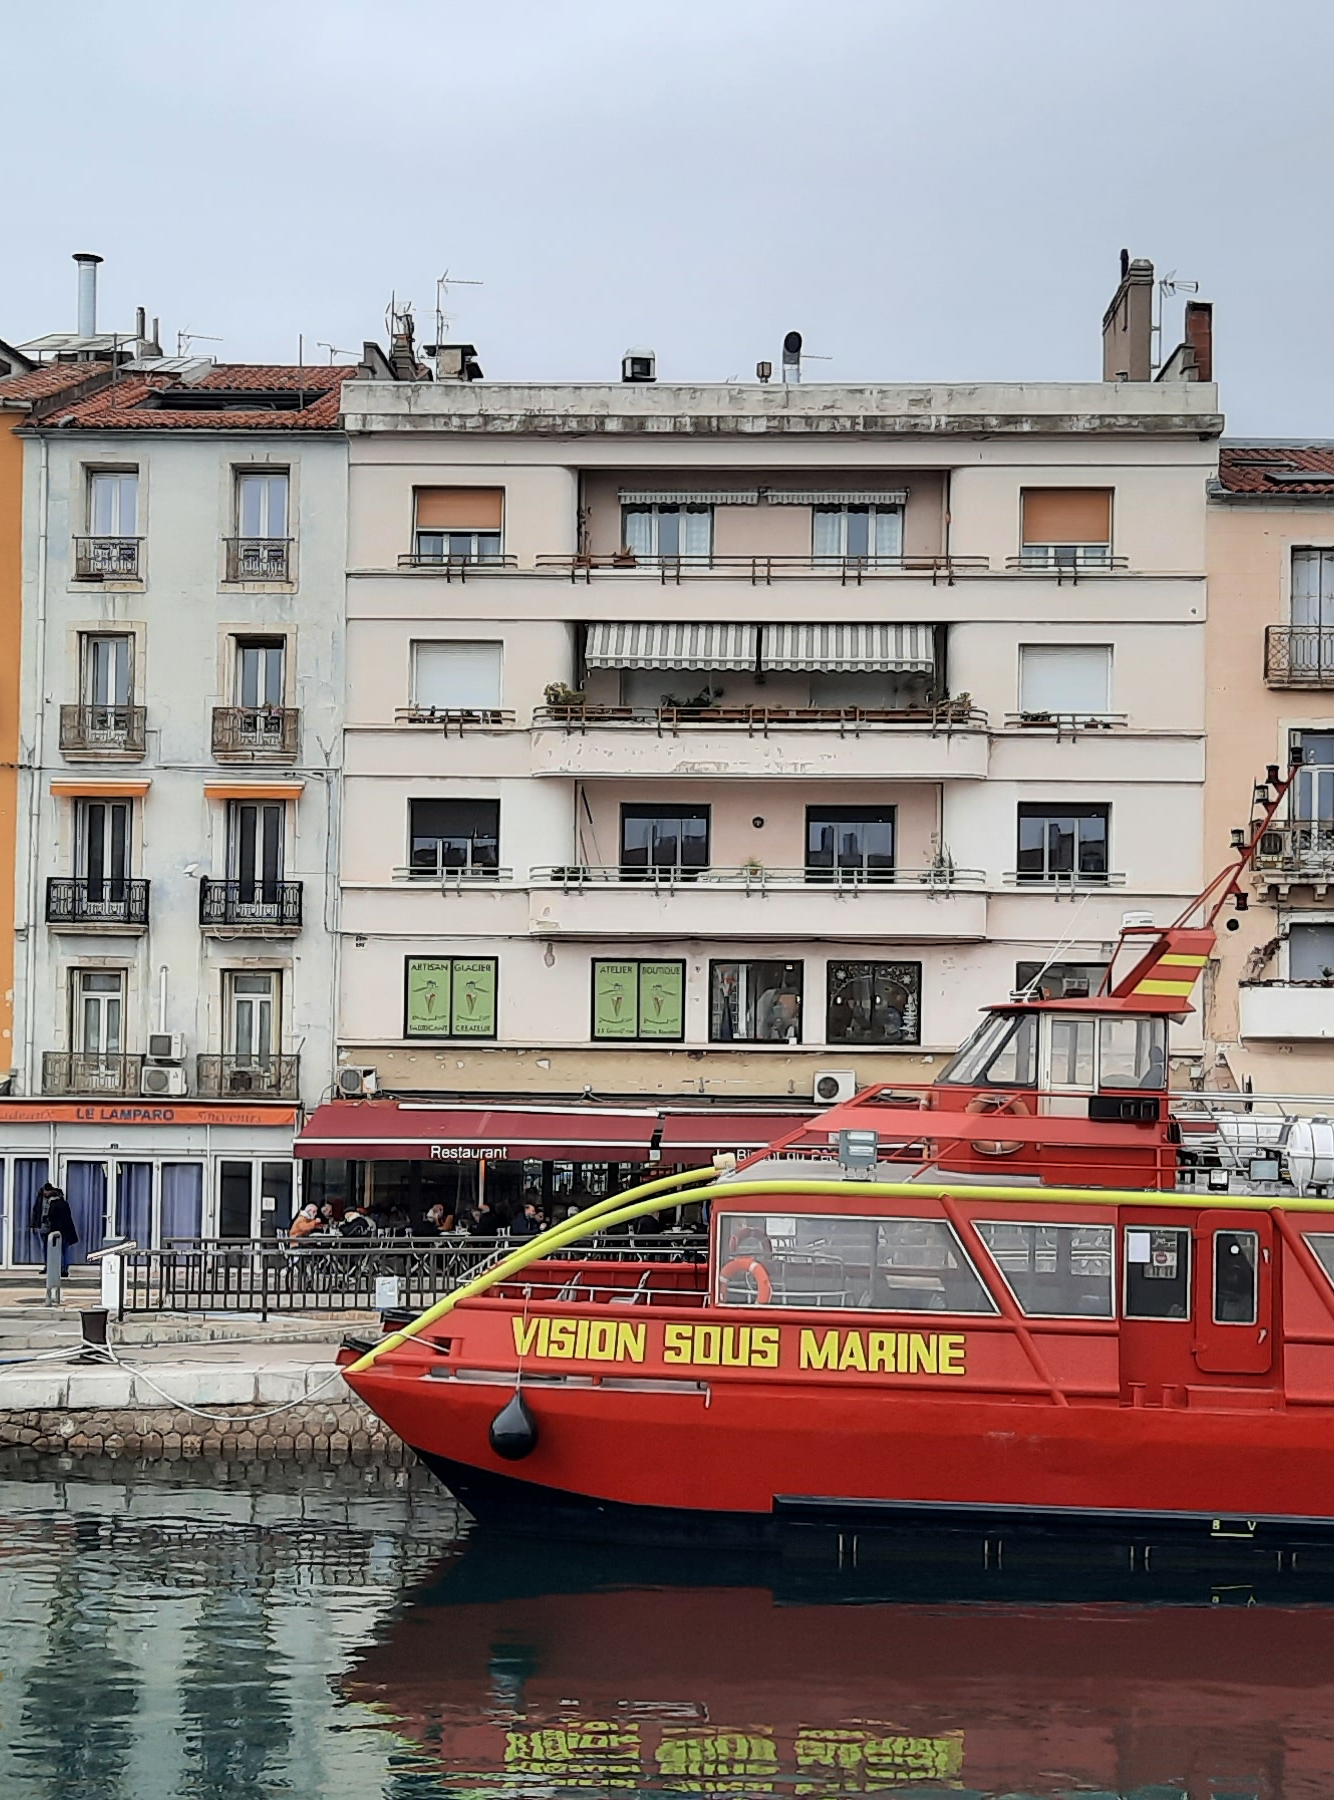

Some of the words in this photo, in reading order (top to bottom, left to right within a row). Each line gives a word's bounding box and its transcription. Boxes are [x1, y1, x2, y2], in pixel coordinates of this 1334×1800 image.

[411, 963, 448, 971] ARTISAN
[454, 964, 491, 972] GLACIER
[599, 966, 633, 974] ATELIER
[642, 966, 680, 975] BOUTIQUE
[76, 1108, 94, 1119] LE
[100, 1108, 174, 1121] LAMPARO
[430, 1145, 507, 1159] Restaurant
[512, 1317, 646, 1363] VISION
[663, 1323, 779, 1368] SOUS
[799, 1329, 966, 1376] MARINE
[1212, 1519, 1220, 1530] B
[1247, 1520, 1257, 1531] V
